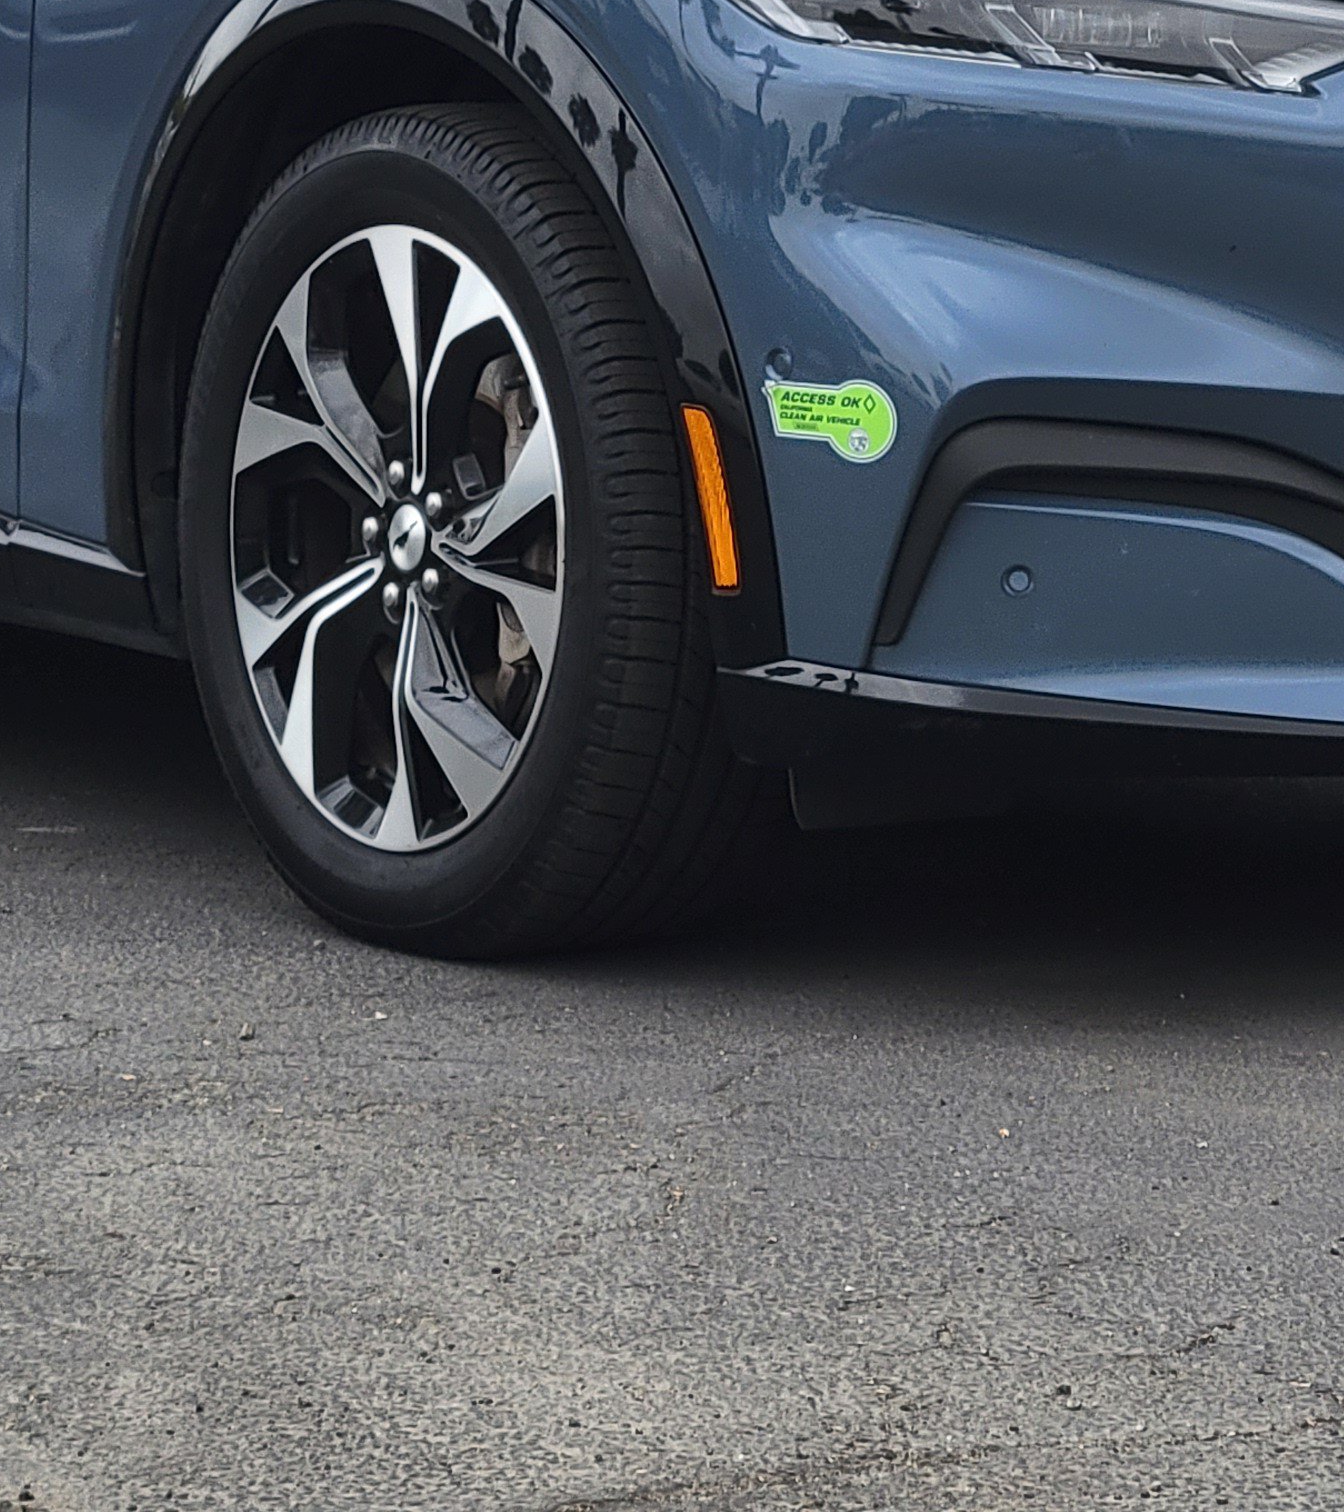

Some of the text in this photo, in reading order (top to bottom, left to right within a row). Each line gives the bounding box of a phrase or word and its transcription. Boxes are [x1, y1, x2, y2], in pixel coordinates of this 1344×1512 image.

[781, 391, 863, 408] ACCESS OK
[779, 411, 862, 426] CLEAN AIR VEHICLE
